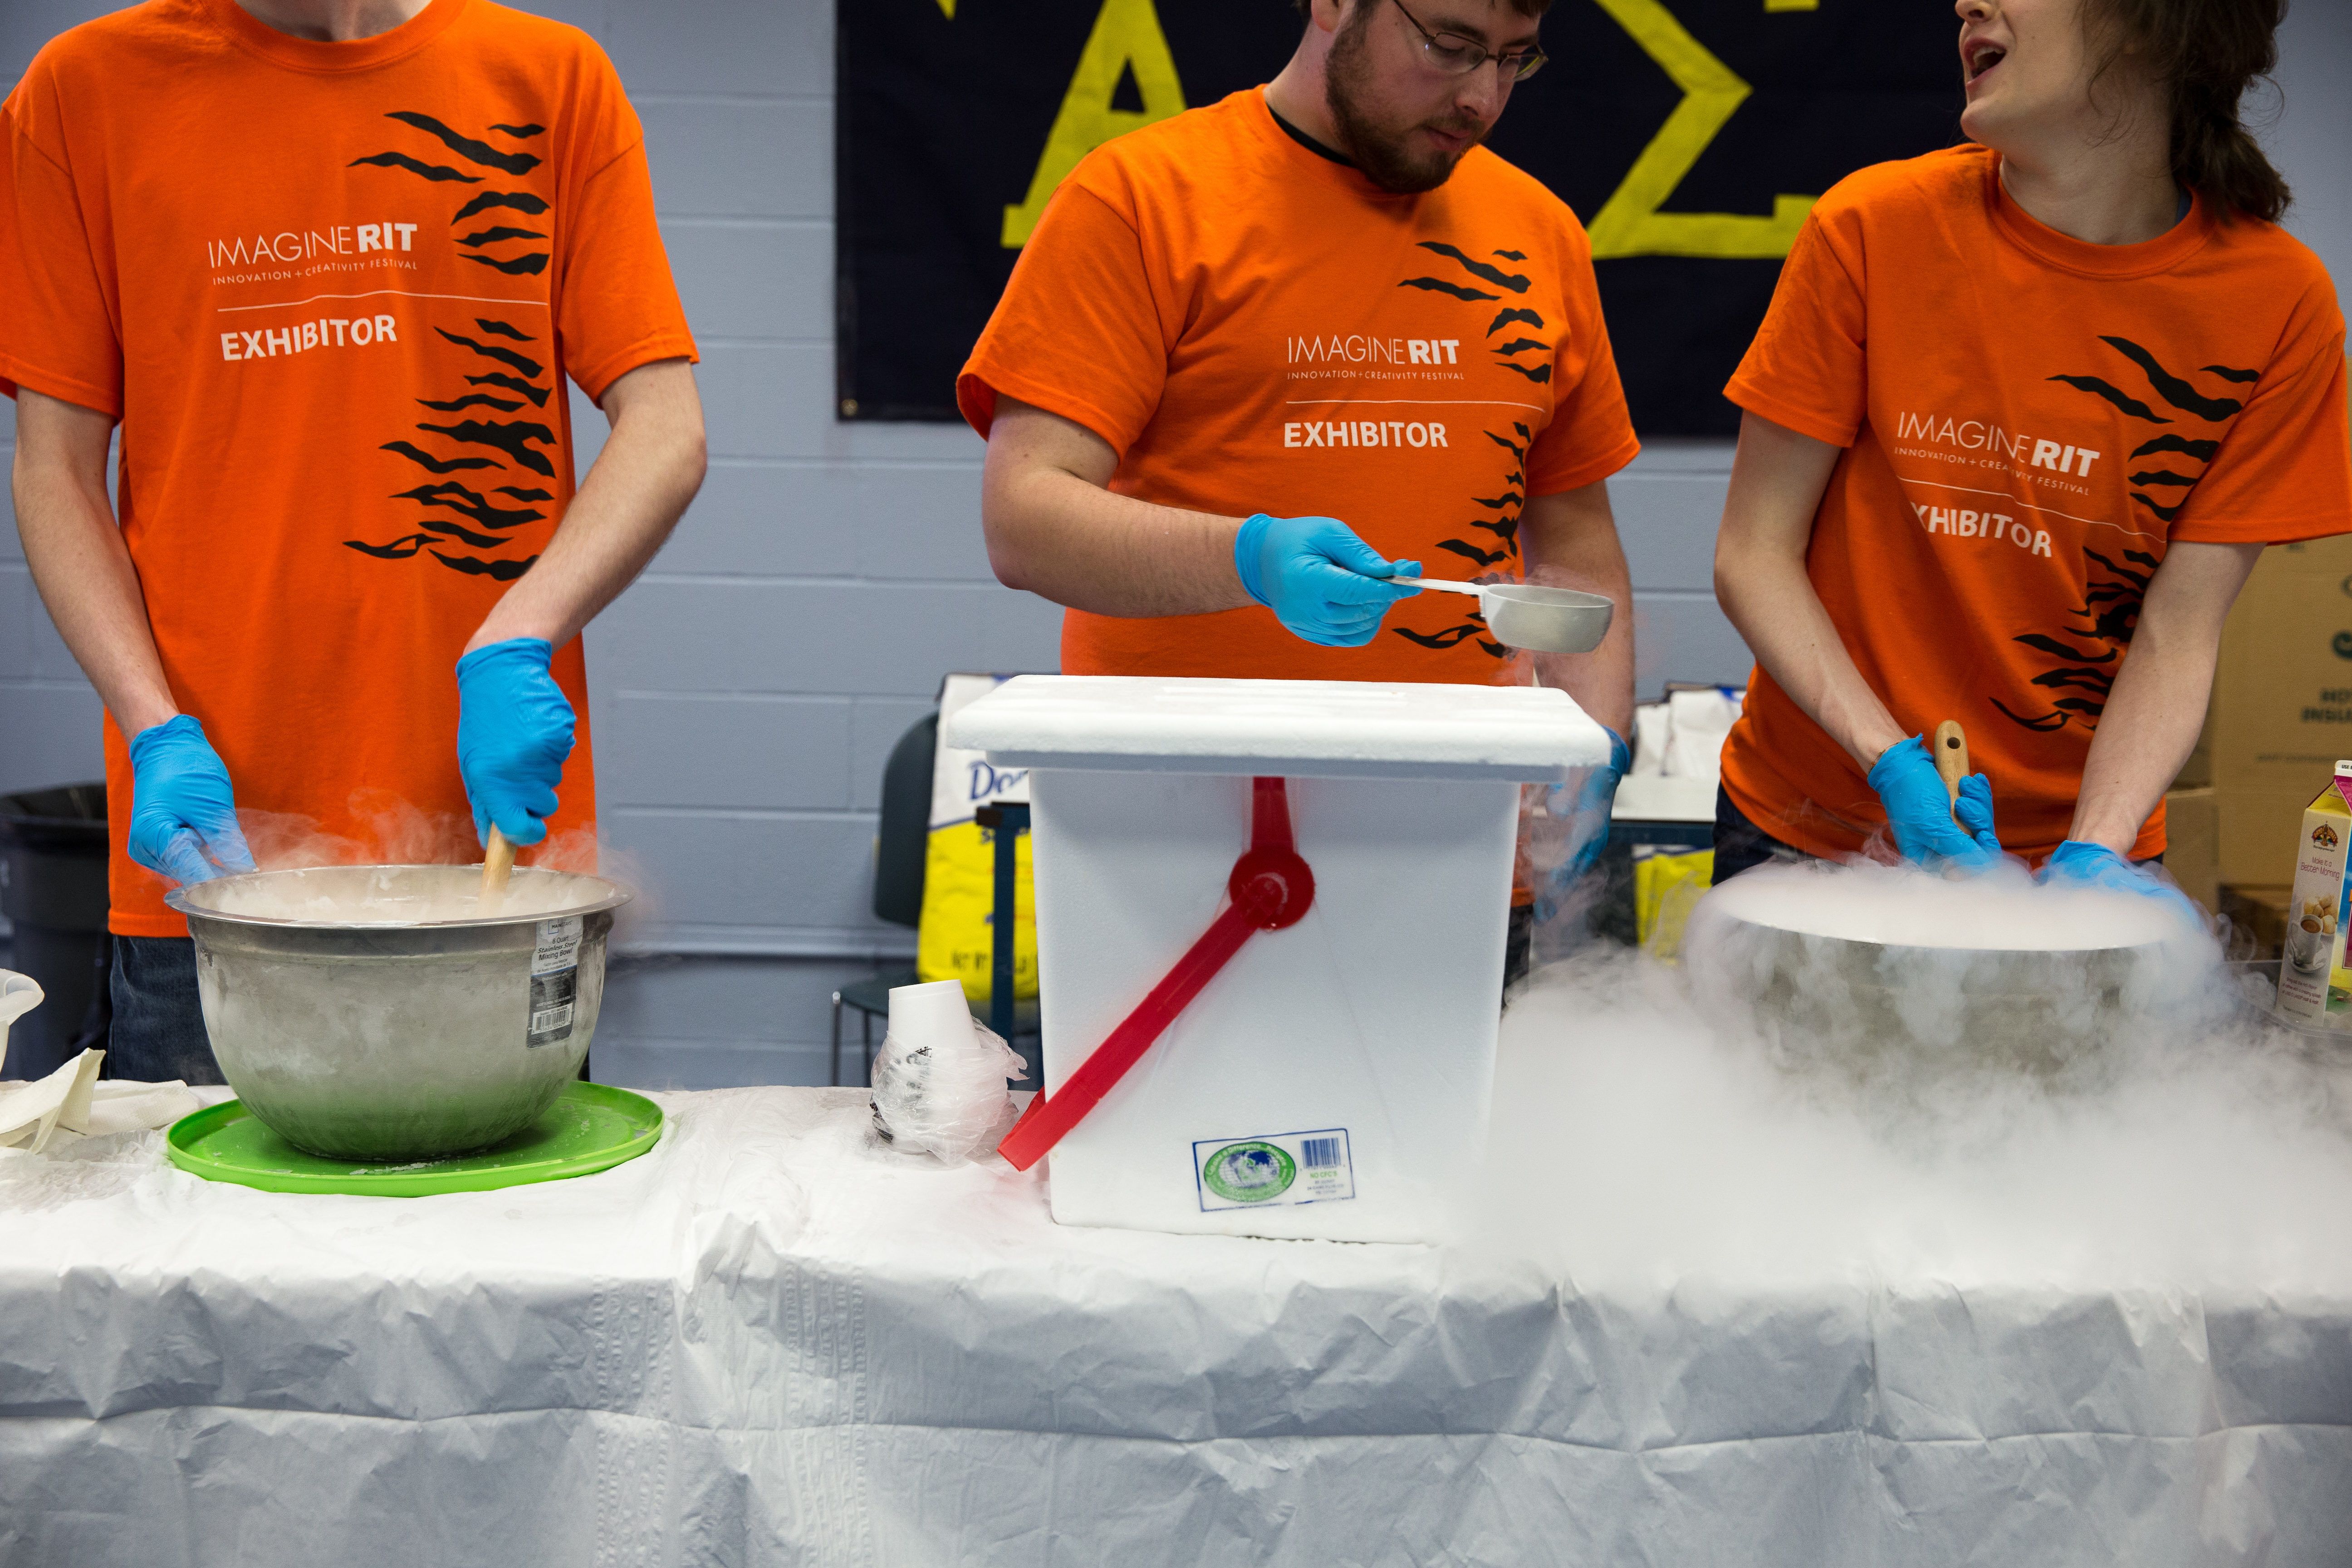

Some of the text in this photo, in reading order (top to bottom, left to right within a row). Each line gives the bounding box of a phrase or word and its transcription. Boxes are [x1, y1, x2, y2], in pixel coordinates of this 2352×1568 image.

[208, 222, 418, 269] IMAGINE RIT
[212, 270, 291, 285] INNOVATION
[305, 262, 365, 276] CREATIVITY
[370, 258, 417, 270] FESTIVAL
[220, 314, 397, 361] EXHIBITOR
[1288, 335, 1460, 365] IMAGINE RIT
[1288, 370, 1357, 380] INNOVATION
[1365, 371, 1417, 380] CREATIVITY
[1421, 372, 1465, 380] FESTIVAL
[1284, 421, 1449, 448] EXHIBITOR
[1897, 411, 2101, 477] IMAGINE RIT
[1895, 446, 1966, 465] INNOVATION
[2037, 476, 2089, 496] FESTIVAL
[1910, 501, 2052, 558] XHIBITOR
[2300, 862, 2340, 881] Better Morning
[537, 939, 578, 954] Stainless Steel
[557, 936, 569, 944] Quart
[538, 947, 573, 961] Mixing Bowl
